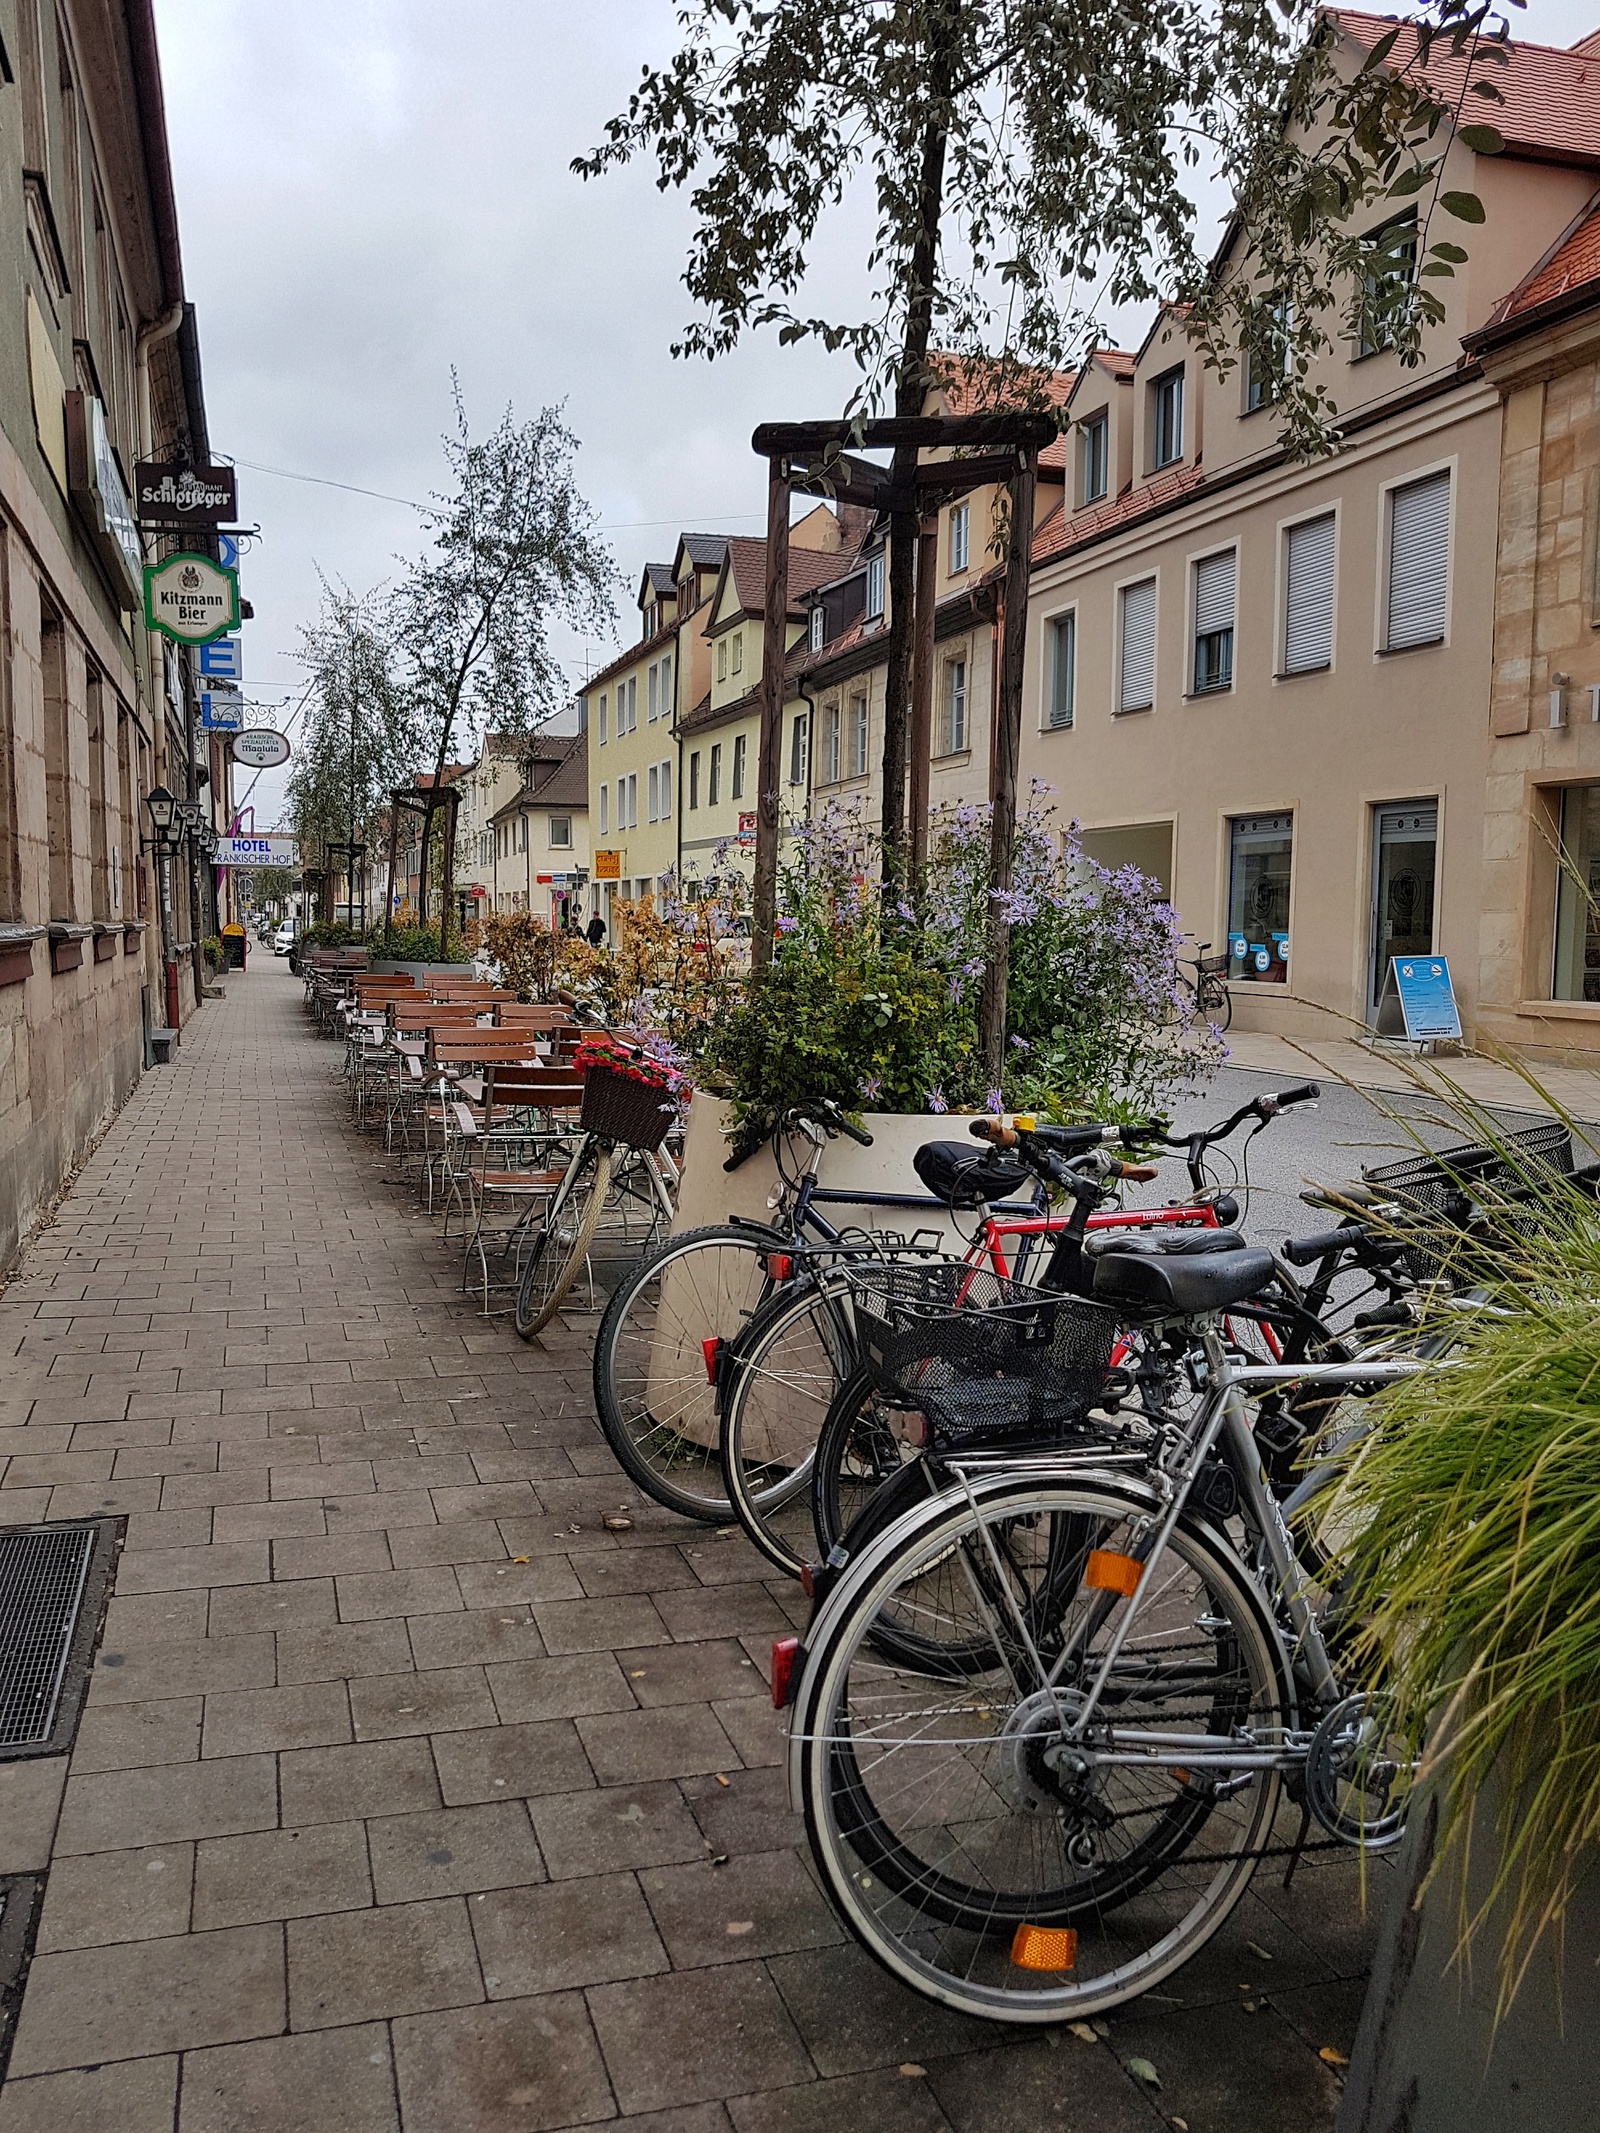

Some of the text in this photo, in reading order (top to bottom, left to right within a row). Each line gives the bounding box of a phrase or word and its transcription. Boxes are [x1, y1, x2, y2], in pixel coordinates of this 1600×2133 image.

[142, 477, 231, 511] Schlotfeger
[178, 484, 223, 492] RESTAURANT
[160, 591, 223, 606] Kitzmann
[178, 606, 206, 619] Bier
[241, 745, 279, 753] Maalula
[232, 840, 271, 852] HOTEL
[272, 855, 291, 864] HOF
